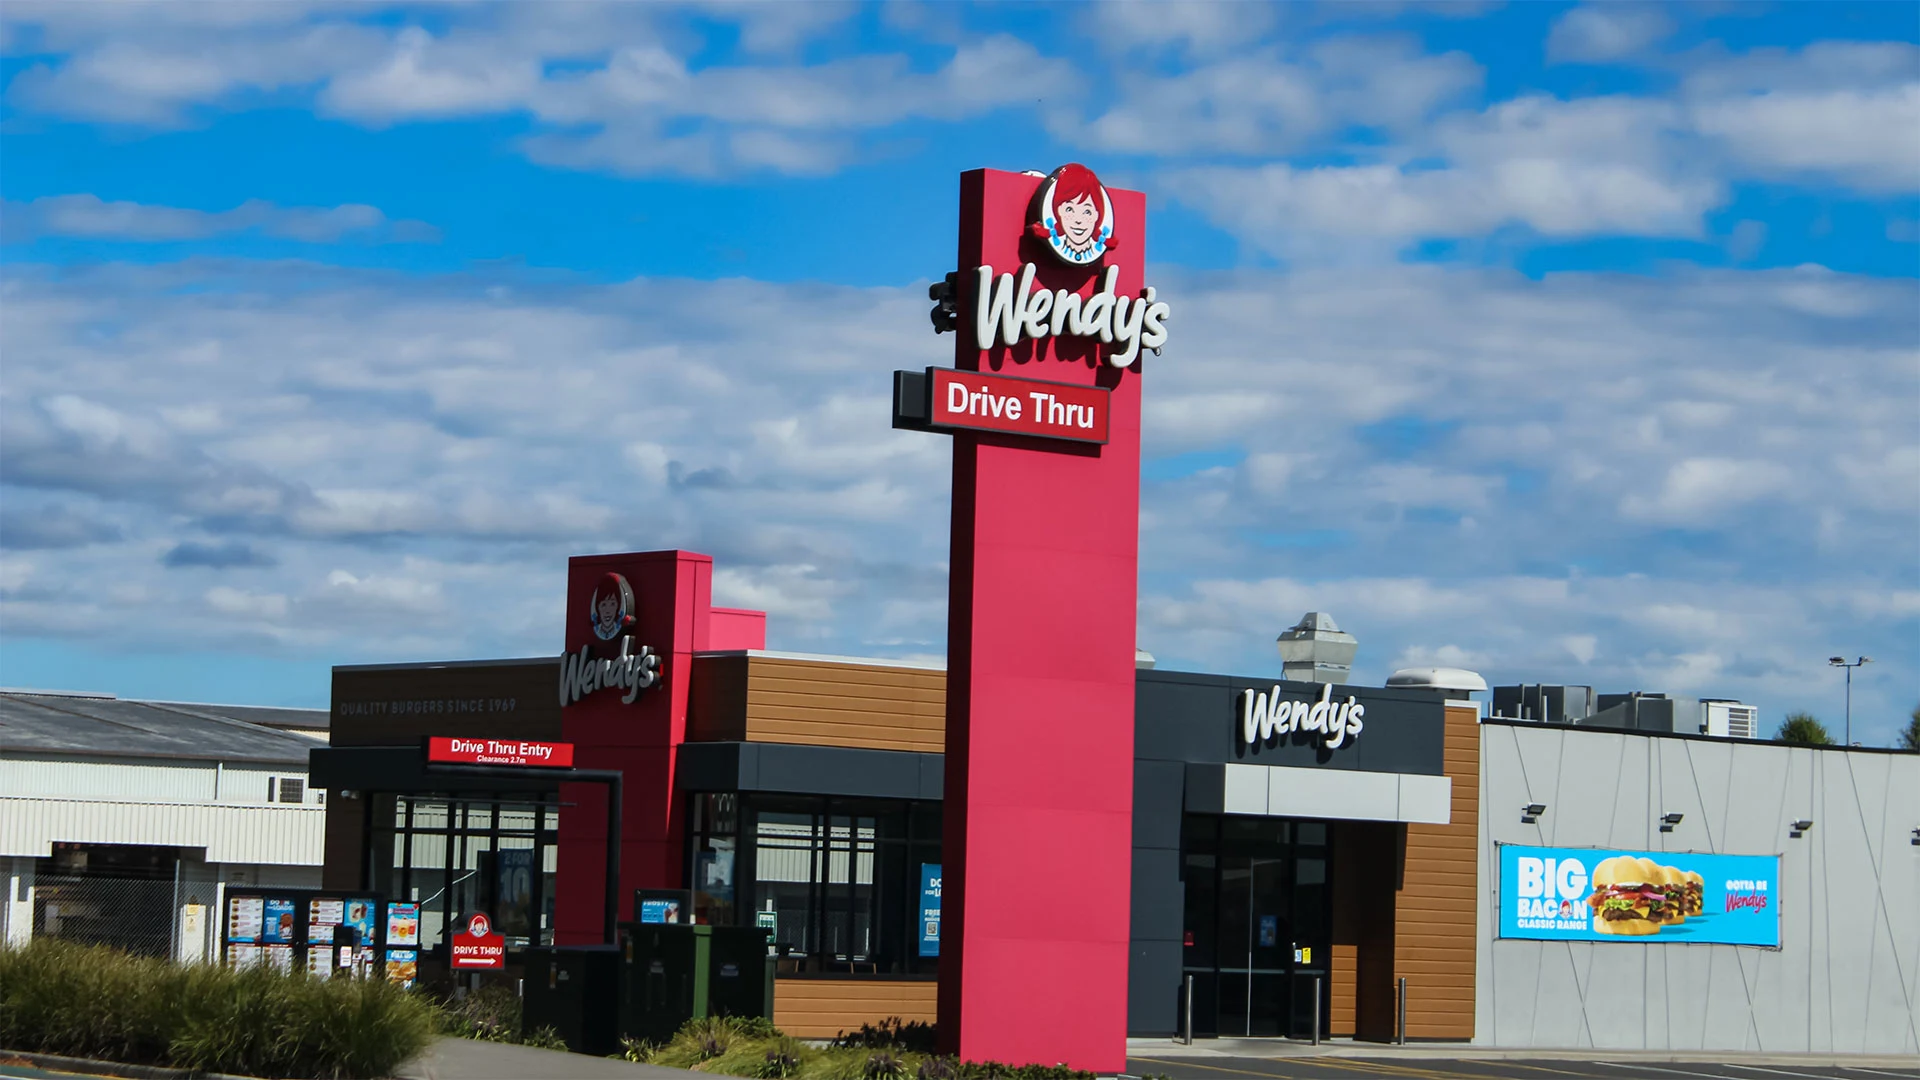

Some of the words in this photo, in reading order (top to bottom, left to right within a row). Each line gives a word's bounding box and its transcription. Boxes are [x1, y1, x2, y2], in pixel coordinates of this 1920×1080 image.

[974, 262, 1171, 368] Wendy's
[947, 382, 1022, 420] Drive
[1030, 391, 1095, 429] Thru
[559, 634, 663, 707] Wendy's
[340, 701, 387, 716] QUALITY
[391, 699, 444, 714] BURGERS
[447, 698, 484, 713] SINCE
[488, 697, 517, 712] 1969
[1244, 683, 1365, 749] Wendy's
[451, 739, 484, 754] Drive
[487, 740, 516, 755] Thru
[519, 742, 553, 760] Entry
[476, 754, 509, 764] Clearance
[510, 756, 526, 764] 2.7m
[1518, 857, 1588, 899] BIG
[1726, 880, 1755, 890] GOTTA
[1756, 880, 1767, 890] BE
[1725, 888, 1767, 914] Wendy's
[1517, 918, 1556, 929] CLASSIC
[1556, 919, 1587, 930] RANGE
[454, 945, 478, 955] DRIVE
[480, 946, 502, 956] THRU
